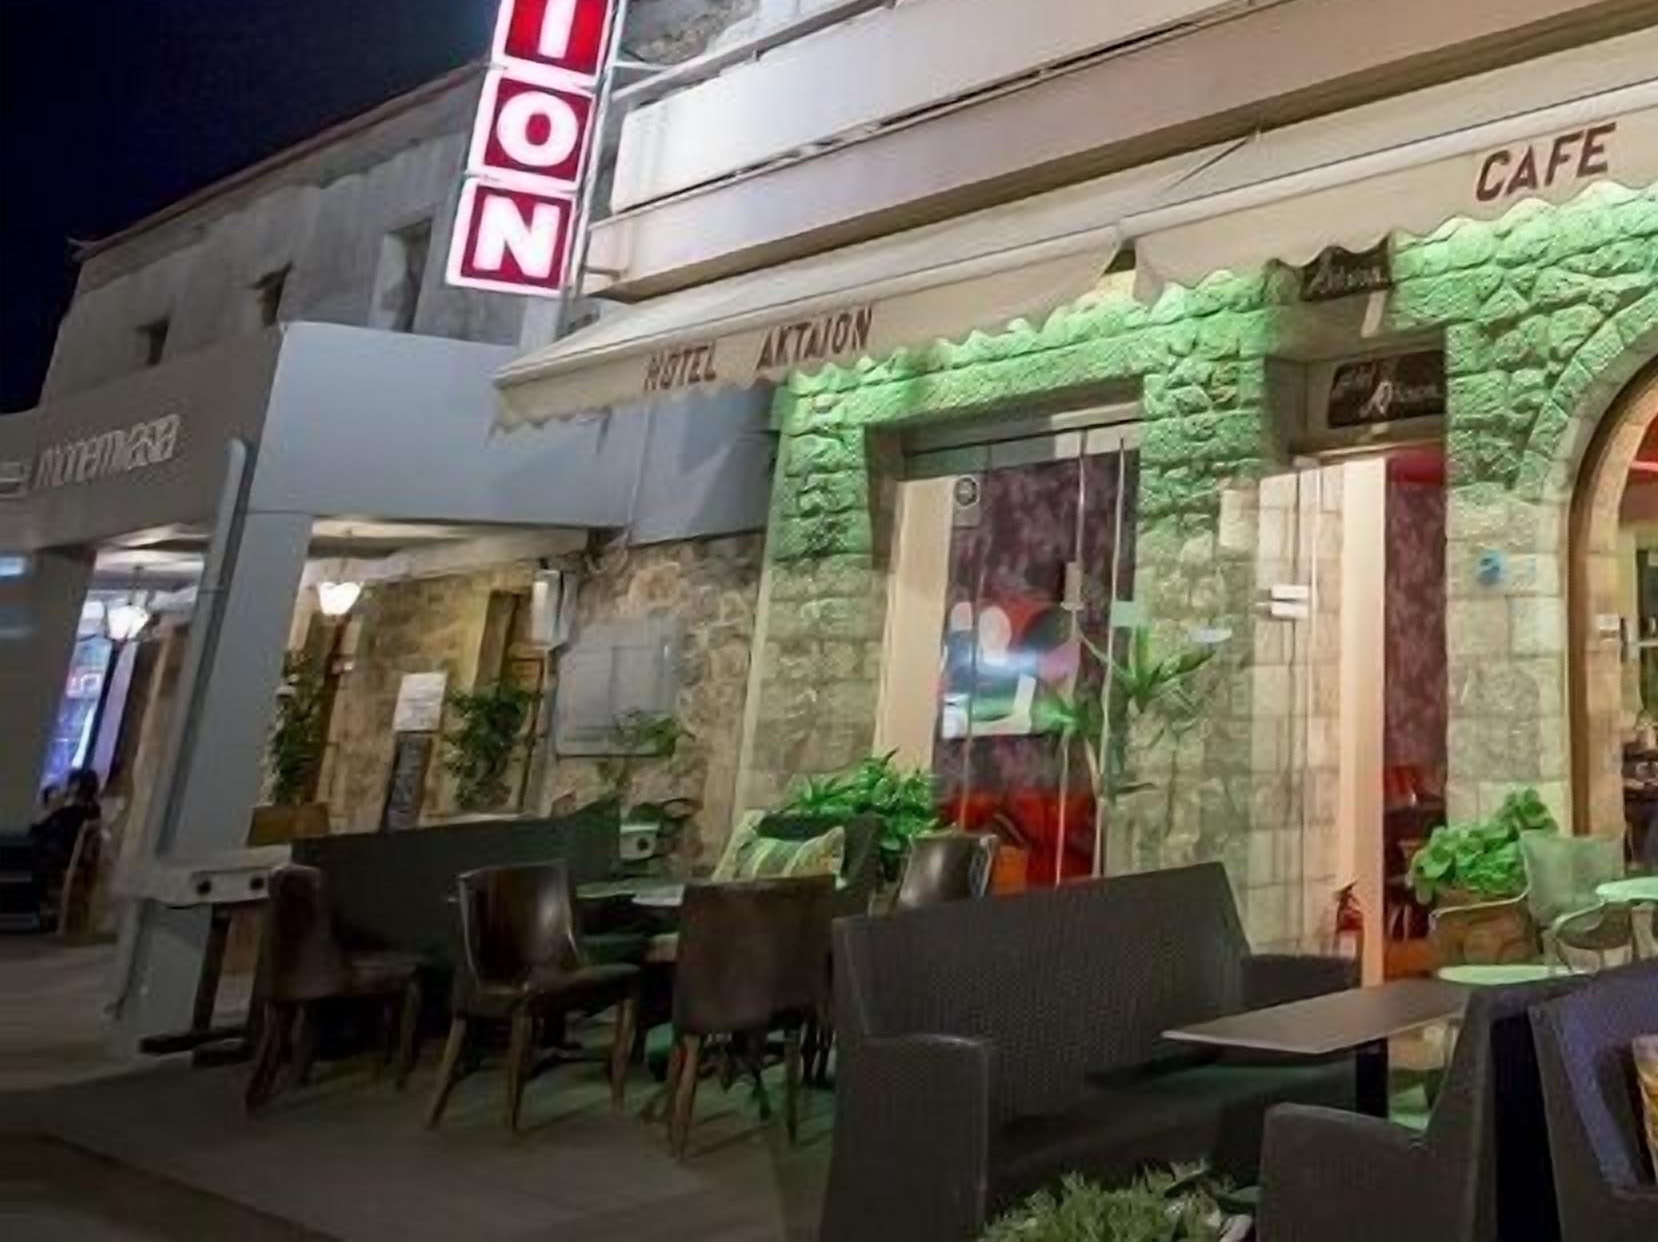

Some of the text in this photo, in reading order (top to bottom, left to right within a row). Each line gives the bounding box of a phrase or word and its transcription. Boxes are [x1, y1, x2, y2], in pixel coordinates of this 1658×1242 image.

[1475, 122, 1617, 202] CAFE
[643, 307, 873, 392] HOTEL AKTAION
